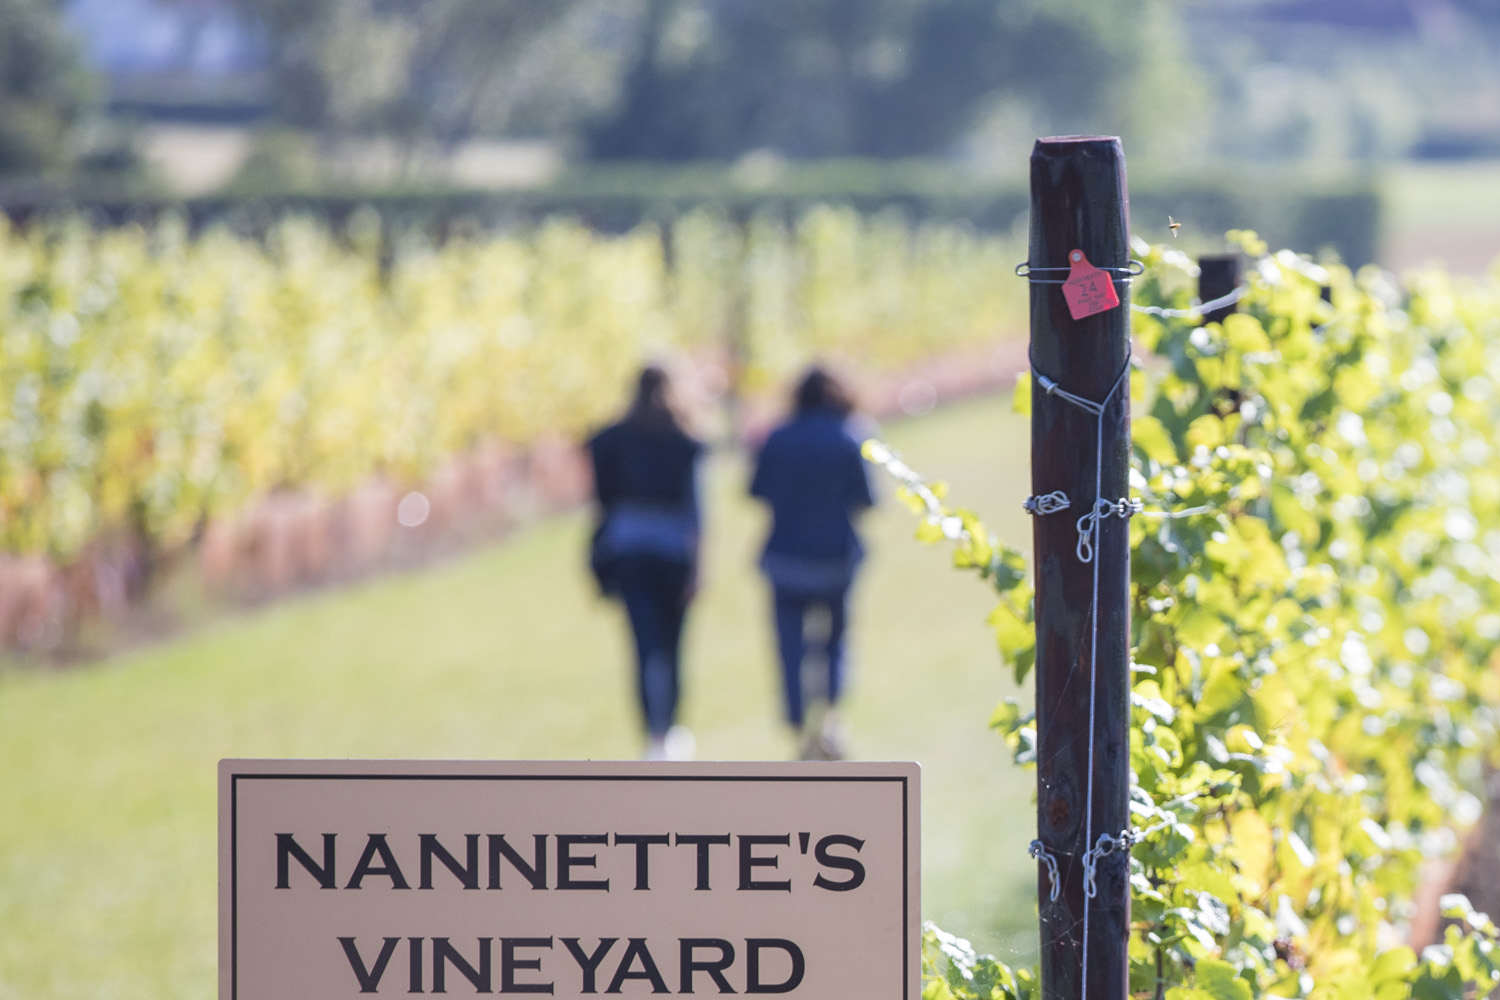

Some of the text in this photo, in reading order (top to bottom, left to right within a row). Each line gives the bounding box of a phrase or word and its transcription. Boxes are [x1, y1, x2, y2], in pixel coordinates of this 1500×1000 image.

[1079, 281, 1097, 297] 24
[274, 831, 866, 893] NANNETTE'S
[336, 935, 806, 996] VINEYARD
